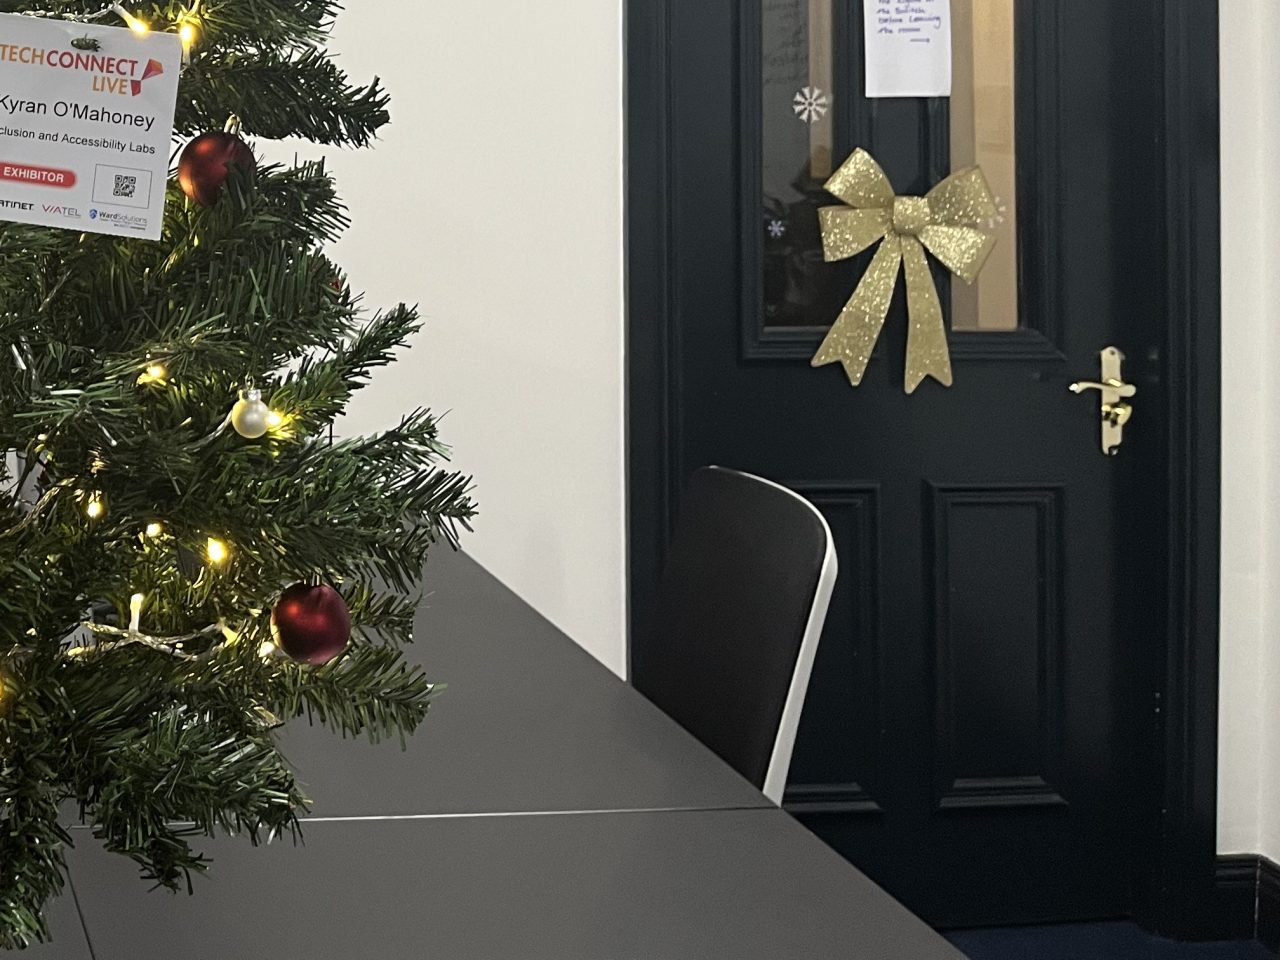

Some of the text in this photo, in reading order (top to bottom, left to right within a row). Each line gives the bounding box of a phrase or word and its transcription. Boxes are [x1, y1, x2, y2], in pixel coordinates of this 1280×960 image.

[92, 75, 128, 95] LIVE
[53, 101, 155, 132] O'Mahoney
[38, 128, 58, 142] and
[61, 133, 127, 152] Accessibility
[129, 142, 156, 155] Labs
[3, 166, 65, 183] EXHIBITOR
[41, 204, 81, 216] VIATEL
